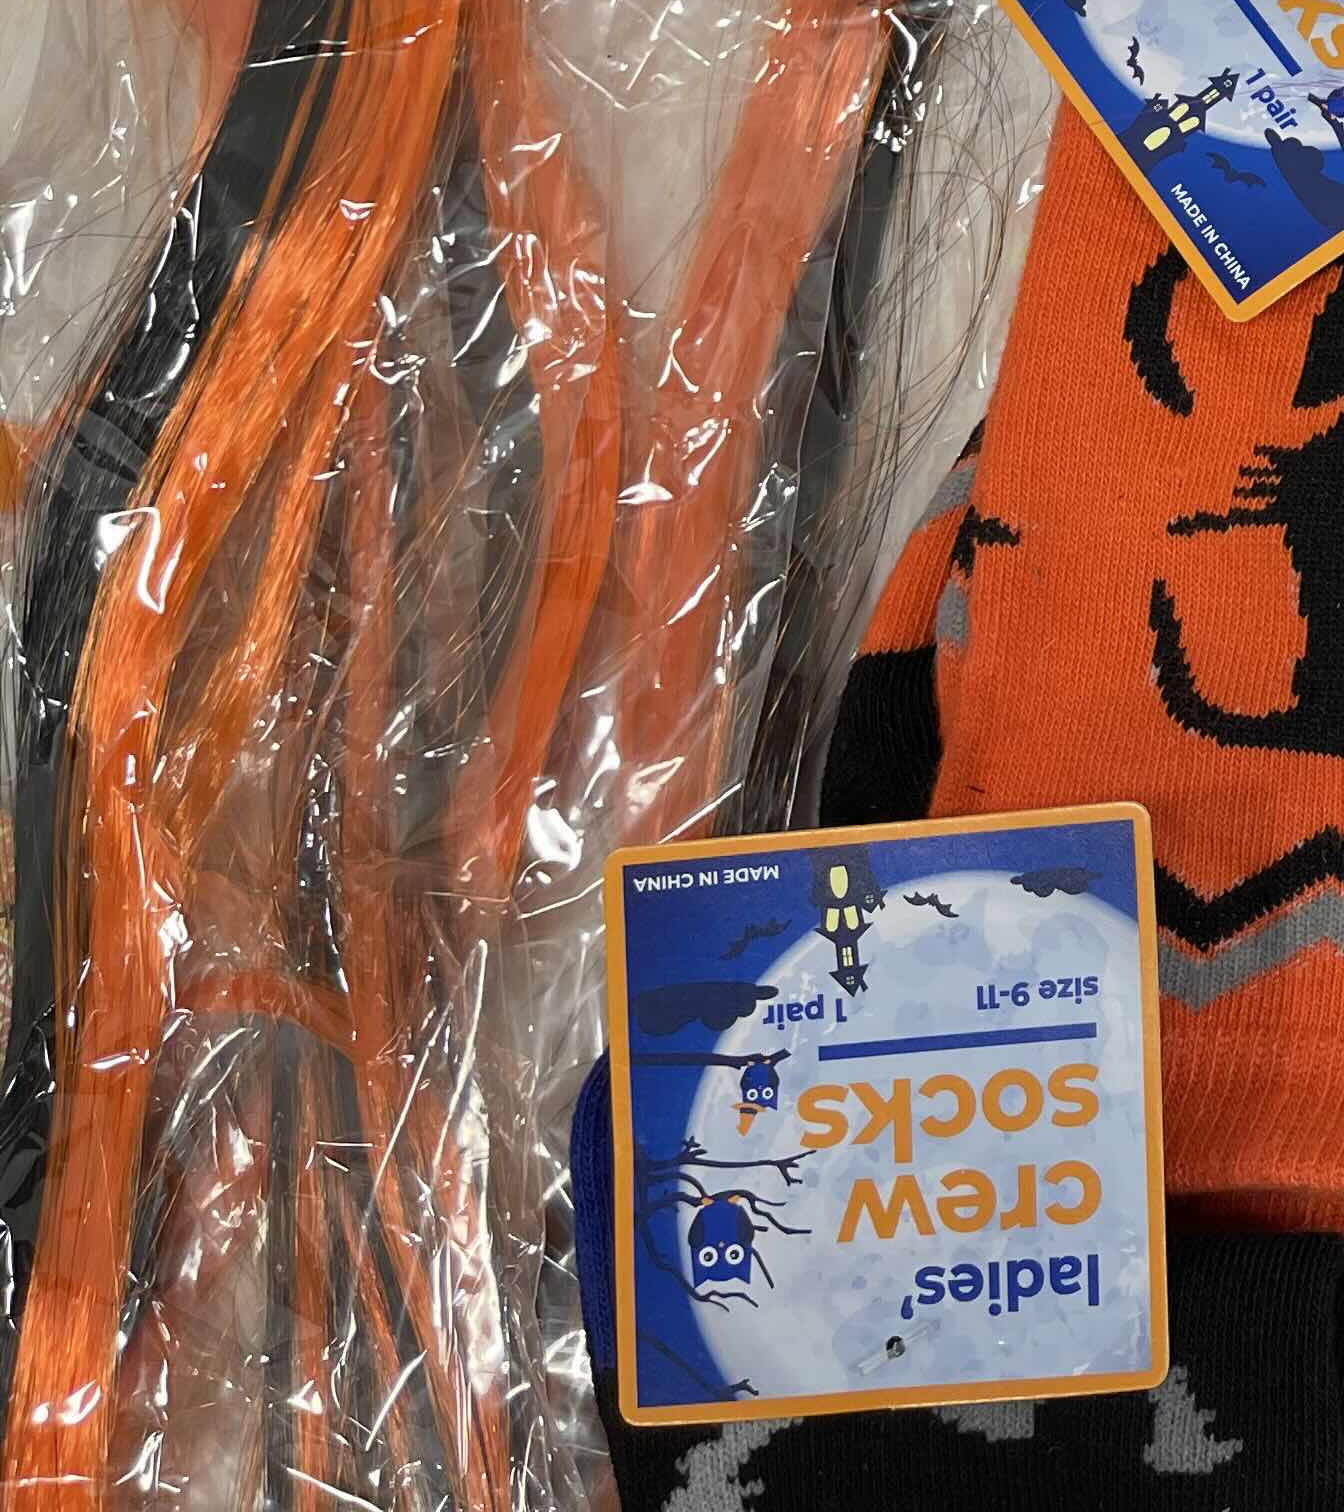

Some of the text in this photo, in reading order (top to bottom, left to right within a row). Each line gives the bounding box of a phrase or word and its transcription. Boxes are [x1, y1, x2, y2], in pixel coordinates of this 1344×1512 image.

[1245, 69, 1299, 132] 1 pair
[1170, 183, 1251, 291] MADE IN CHINA
[634, 865, 779, 894] MADE IN CHINA
[763, 993, 847, 1029] 1 pair
[976, 974, 1100, 1009] size 9-11
[799, 1062, 1100, 1164] socks
[837, 1160, 1103, 1244] crew
[901, 1253, 1100, 1321] ladies'
